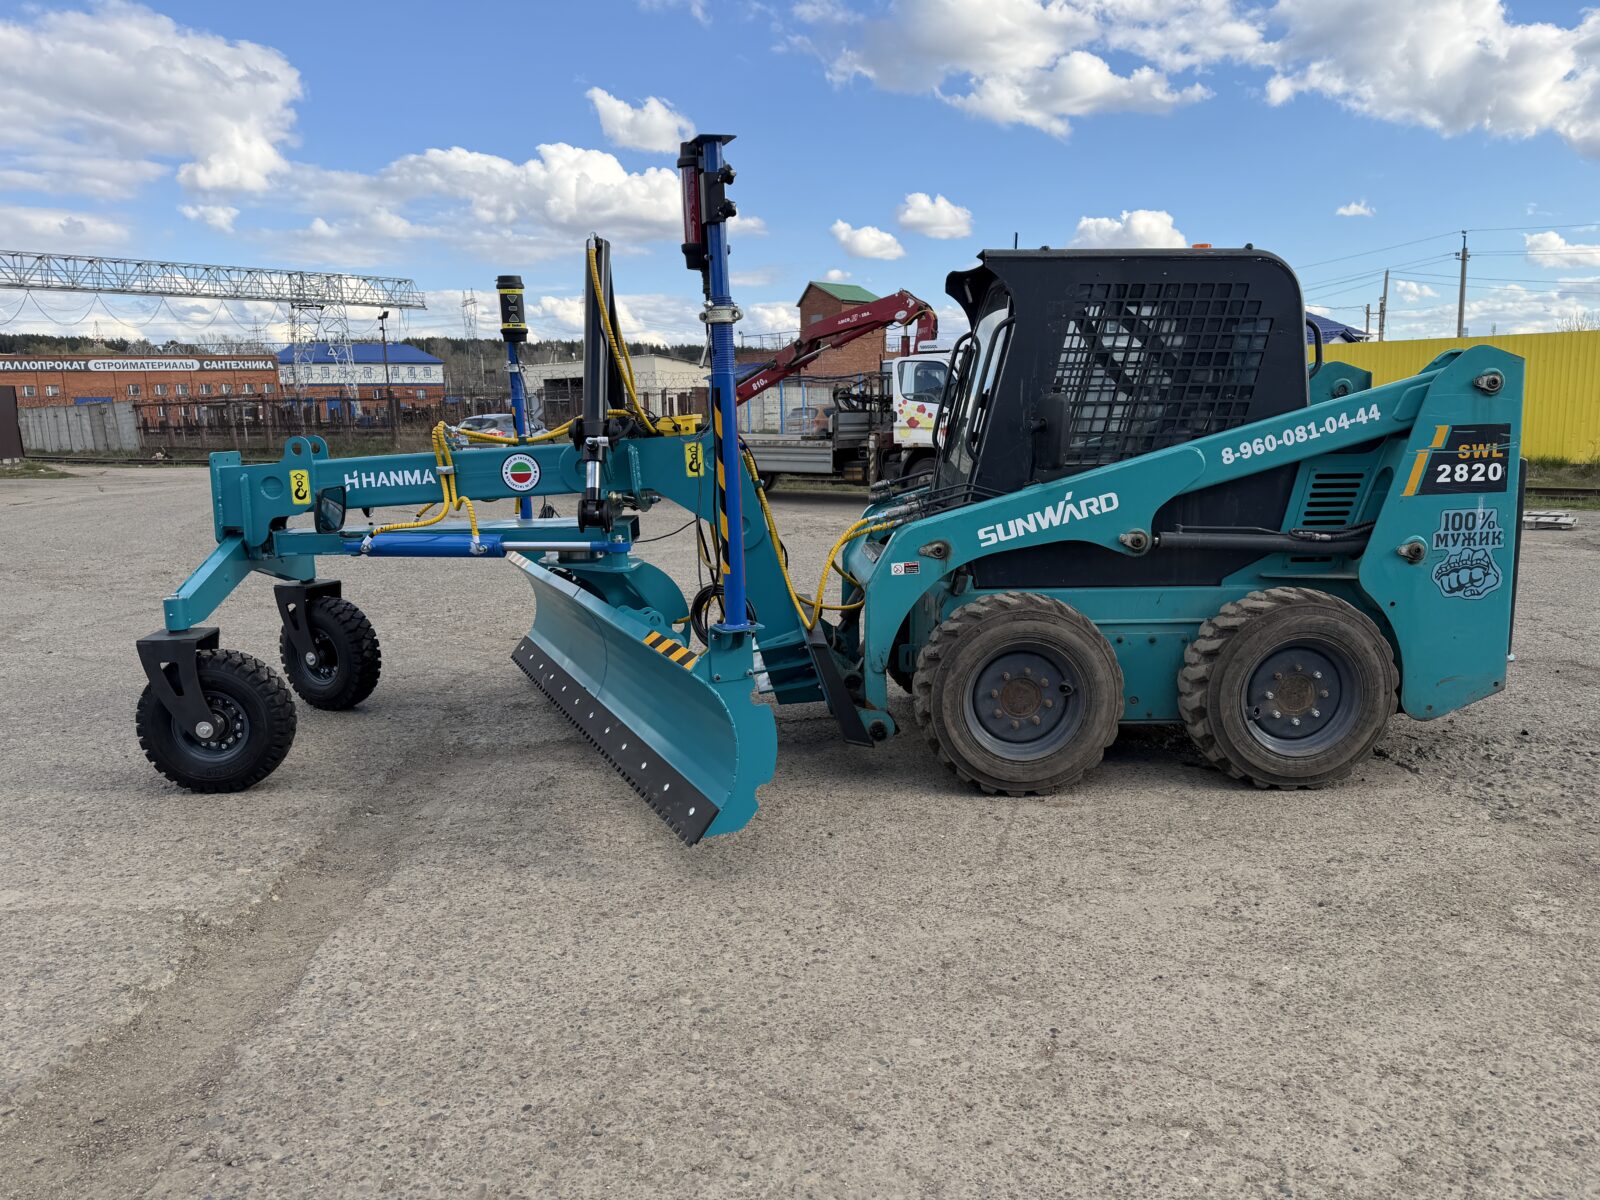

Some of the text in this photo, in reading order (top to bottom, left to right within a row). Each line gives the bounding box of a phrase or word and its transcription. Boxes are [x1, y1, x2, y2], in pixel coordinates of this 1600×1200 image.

[94, 361, 195, 370] СТРОЙМАТЕРИАЛЫ
[203, 360, 274, 369] САНТЕХНИКА
[1221, 404, 1381, 465] 8-960-081-04-44
[1458, 443, 1504, 459] SWL
[1436, 463, 1502, 483] 2820
[977, 491, 1119, 547] SUNWARD
[1443, 511, 1495, 531] 100%
[1435, 530, 1504, 547] МУЖИК
